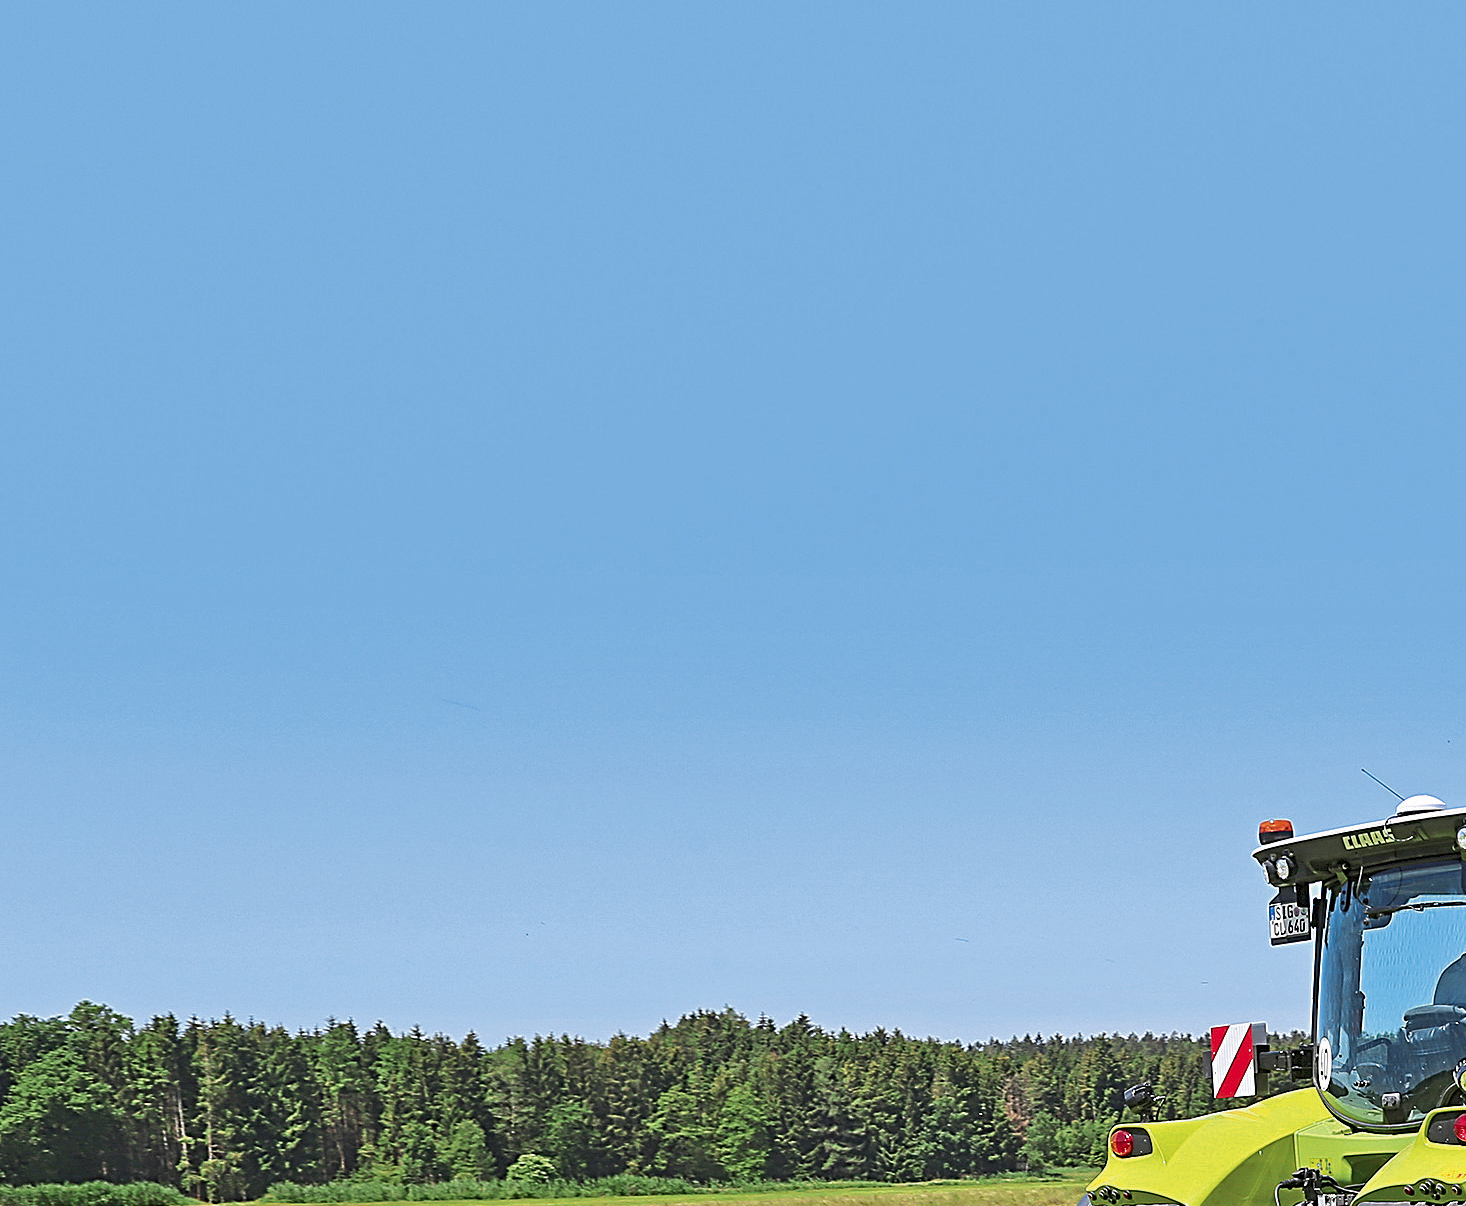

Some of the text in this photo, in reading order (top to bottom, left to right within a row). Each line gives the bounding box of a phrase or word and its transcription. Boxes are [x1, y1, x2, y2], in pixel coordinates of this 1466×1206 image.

[1342, 828, 1396, 850] CLAAS
[1276, 905, 1293, 920] SIG
[1288, 919, 1306, 934] 640
